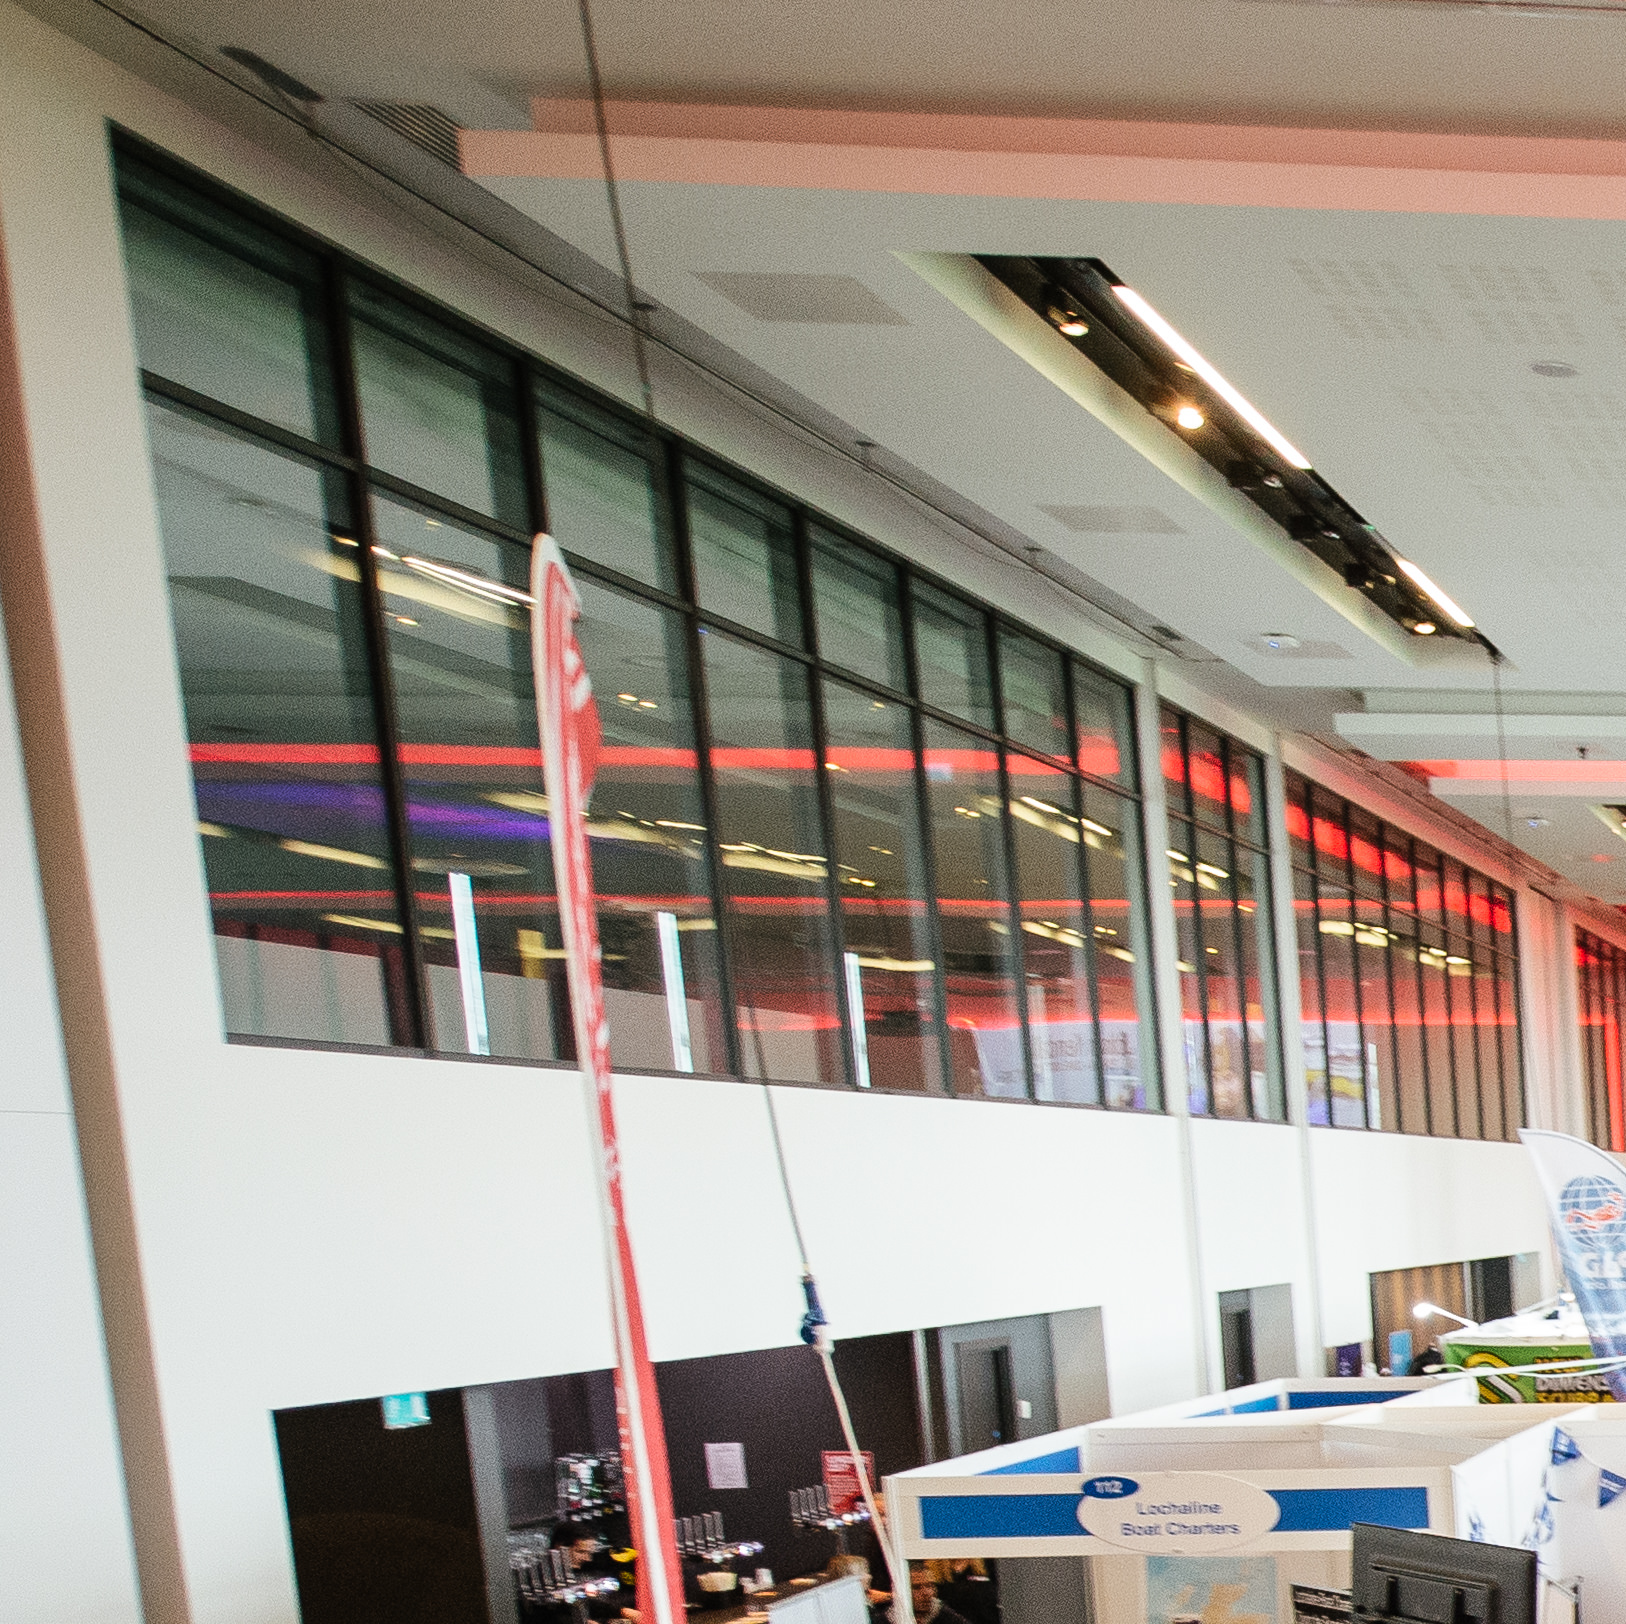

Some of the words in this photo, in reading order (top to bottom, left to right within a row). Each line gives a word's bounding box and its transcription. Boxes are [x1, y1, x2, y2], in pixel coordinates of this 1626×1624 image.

[1135, 1501, 1223, 1517] Lochaline
[1120, 1522, 1162, 1536] Boat
[1165, 1521, 1242, 1536] Charters
